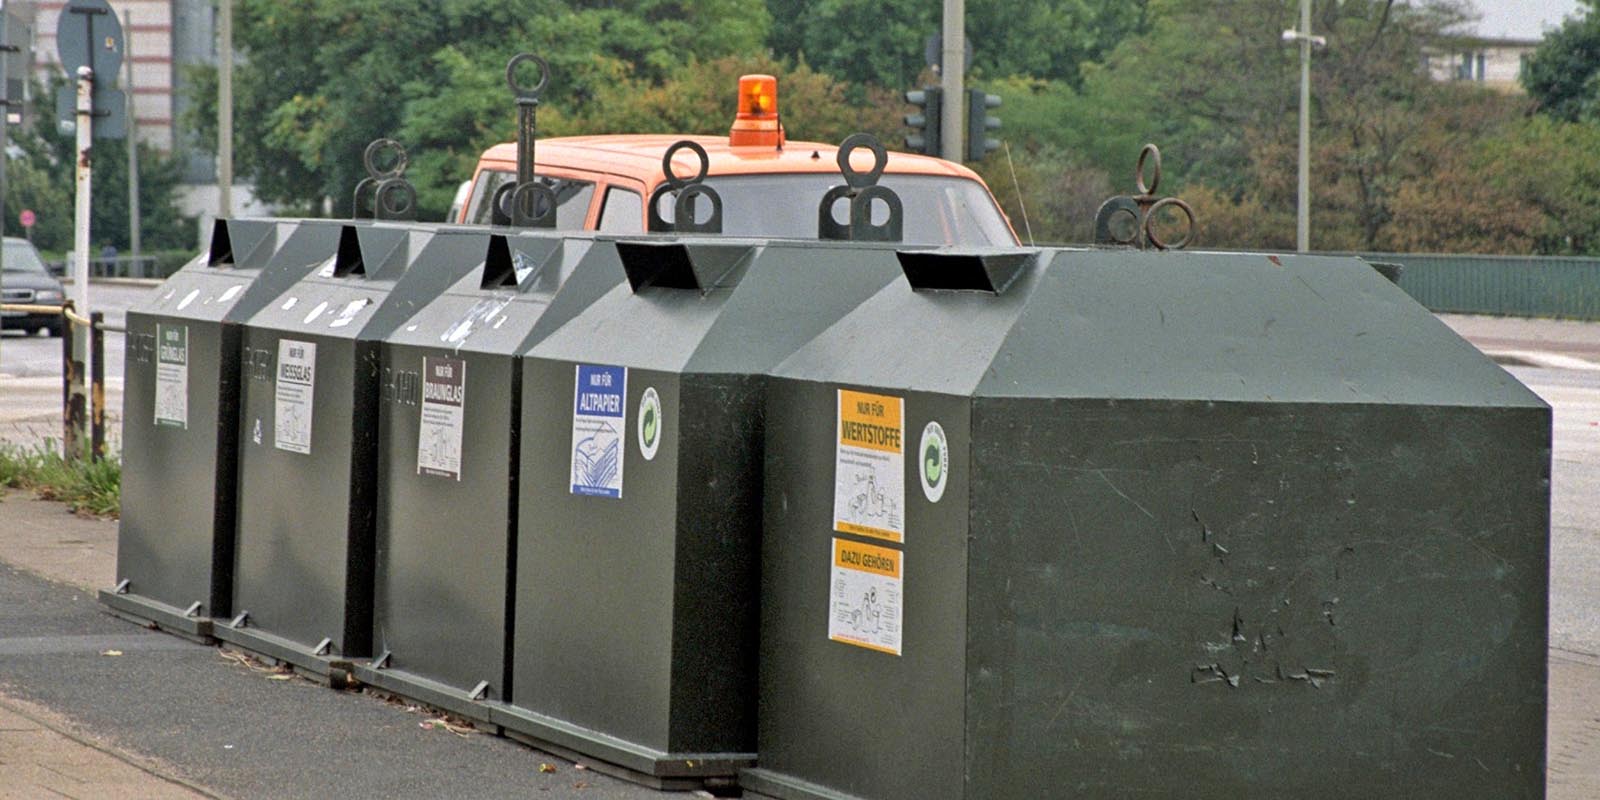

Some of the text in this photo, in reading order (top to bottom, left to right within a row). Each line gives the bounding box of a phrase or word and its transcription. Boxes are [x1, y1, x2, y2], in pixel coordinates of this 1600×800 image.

[281, 363, 311, 381] WEISSGLAS
[444, 364, 452, 378] FÜR
[590, 372, 612, 386] NUR FÜR
[426, 382, 462, 402] BRAUNGLAS
[580, 393, 620, 412] ALTPAPIER
[857, 401, 884, 416] NUR FÜR
[842, 420, 900, 448] WERTSTOFFE
[842, 550, 894, 572] DAZU GEHÖREN
